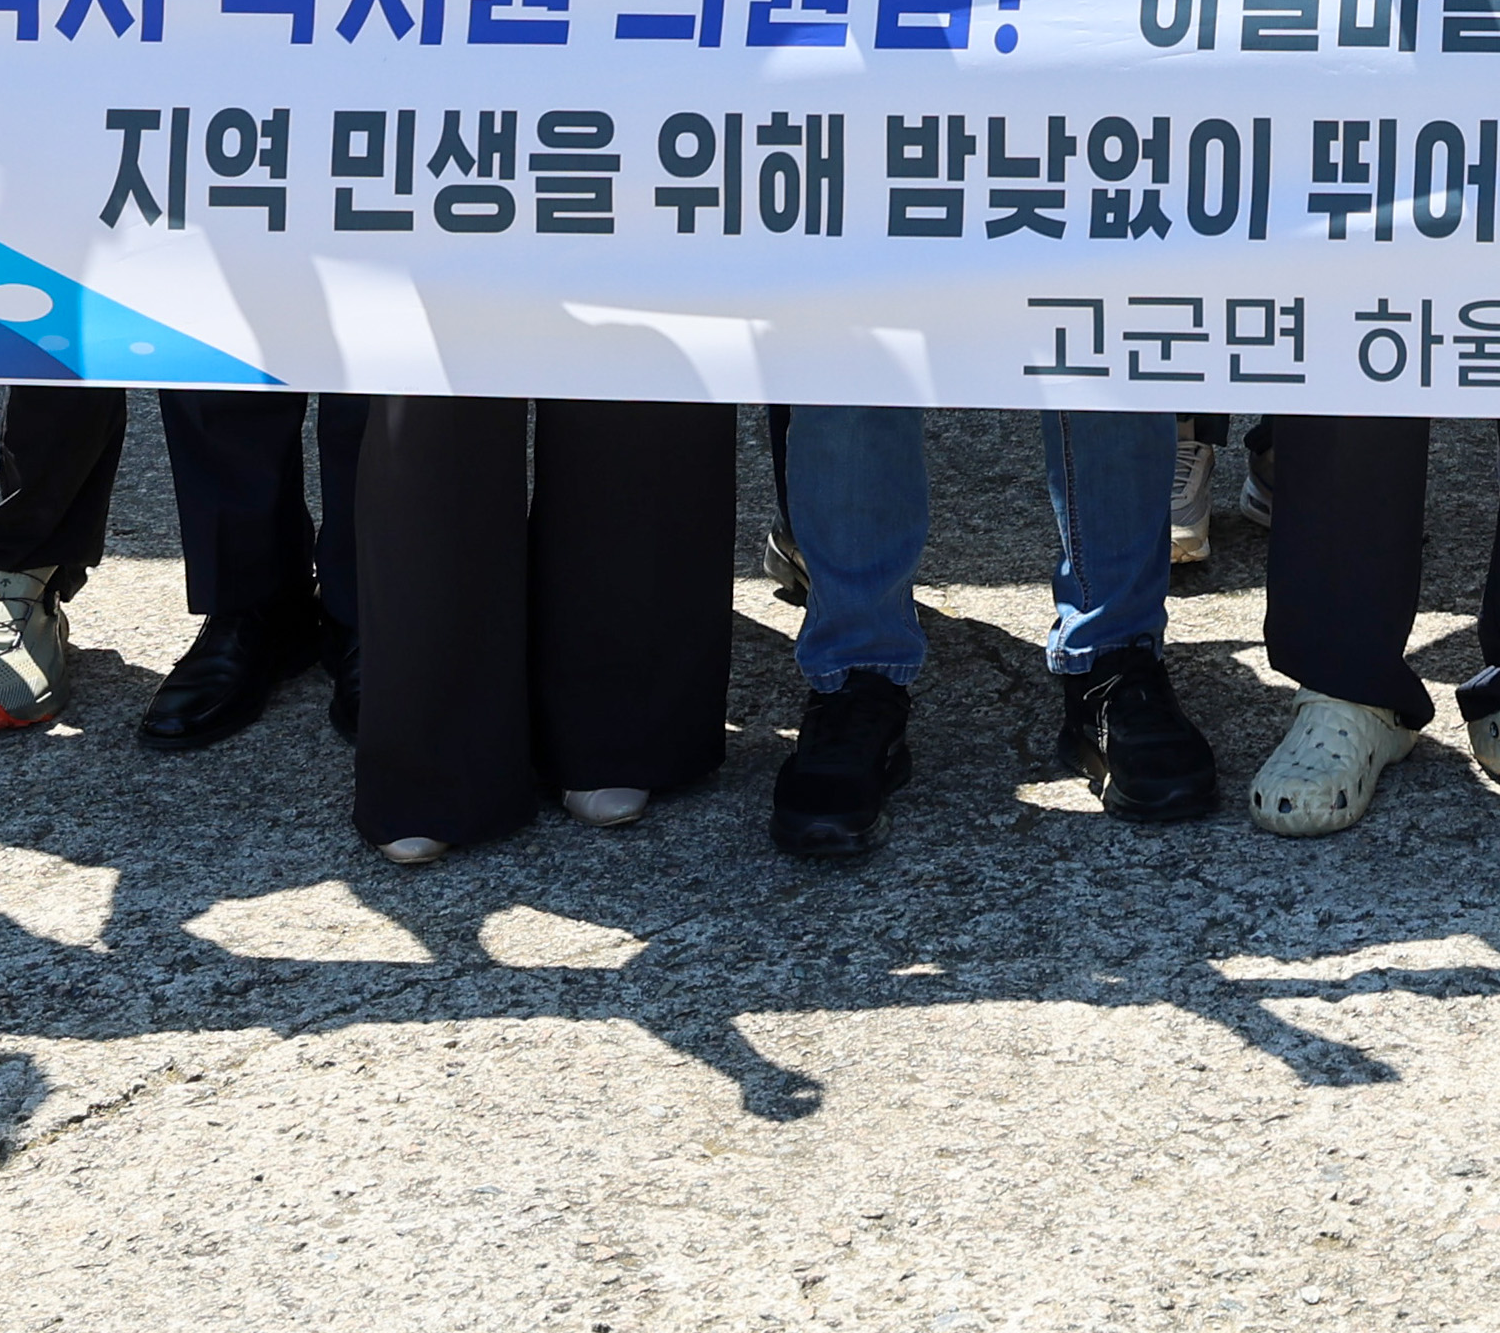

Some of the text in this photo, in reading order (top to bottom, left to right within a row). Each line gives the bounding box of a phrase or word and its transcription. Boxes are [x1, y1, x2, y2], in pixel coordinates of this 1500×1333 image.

[100, 107, 290, 232] 지역
[331, 110, 620, 234] 민생을
[655, 112, 844, 237] 위해
[887, 115, 1271, 240] 밤낮없이
[1023, 297, 1305, 384] 고군면
